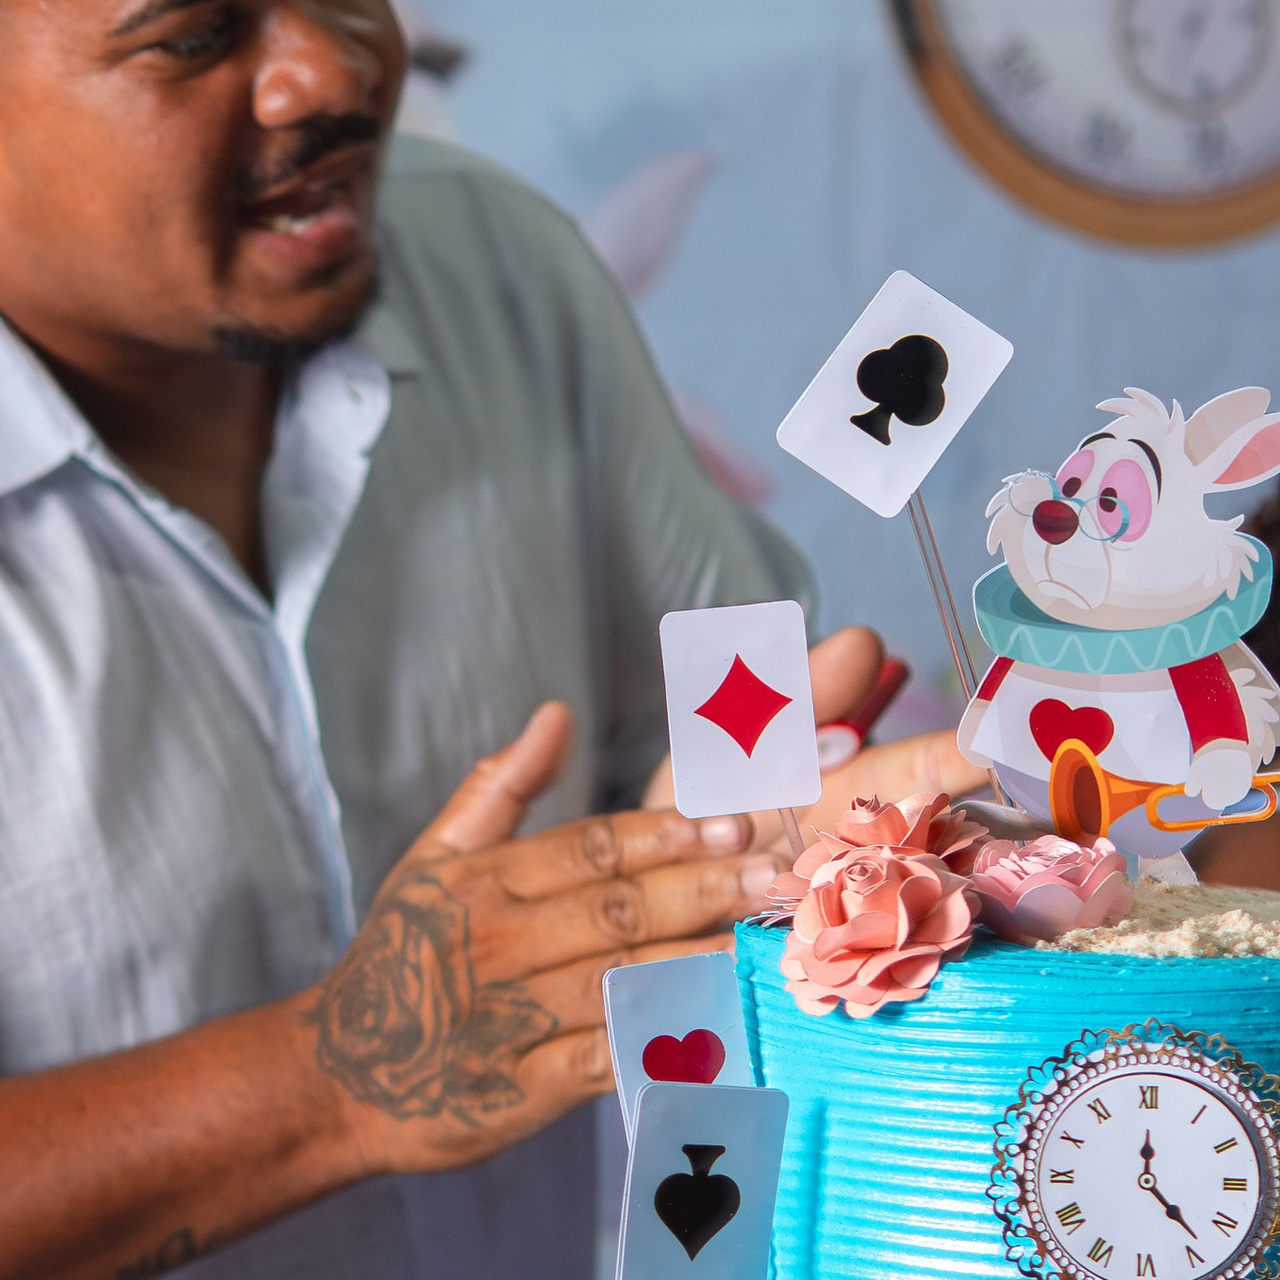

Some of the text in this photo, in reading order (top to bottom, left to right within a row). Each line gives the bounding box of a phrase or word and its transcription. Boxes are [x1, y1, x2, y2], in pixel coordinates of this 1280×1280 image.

[1138, 1085, 1159, 1109] XII
[1087, 1097, 1112, 1124] XI
[1060, 1130, 1085, 1150] X
[1213, 1137, 1238, 1154] II
[1050, 1168, 1075, 1184] IX
[1223, 1177, 1248, 1191] III
[1055, 1202, 1087, 1236] VIII
[1212, 1211, 1239, 1238] IV
[1087, 1237, 1114, 1268] VII
[1185, 1244, 1206, 1268] V
[1136, 1253, 1157, 1278] VI
